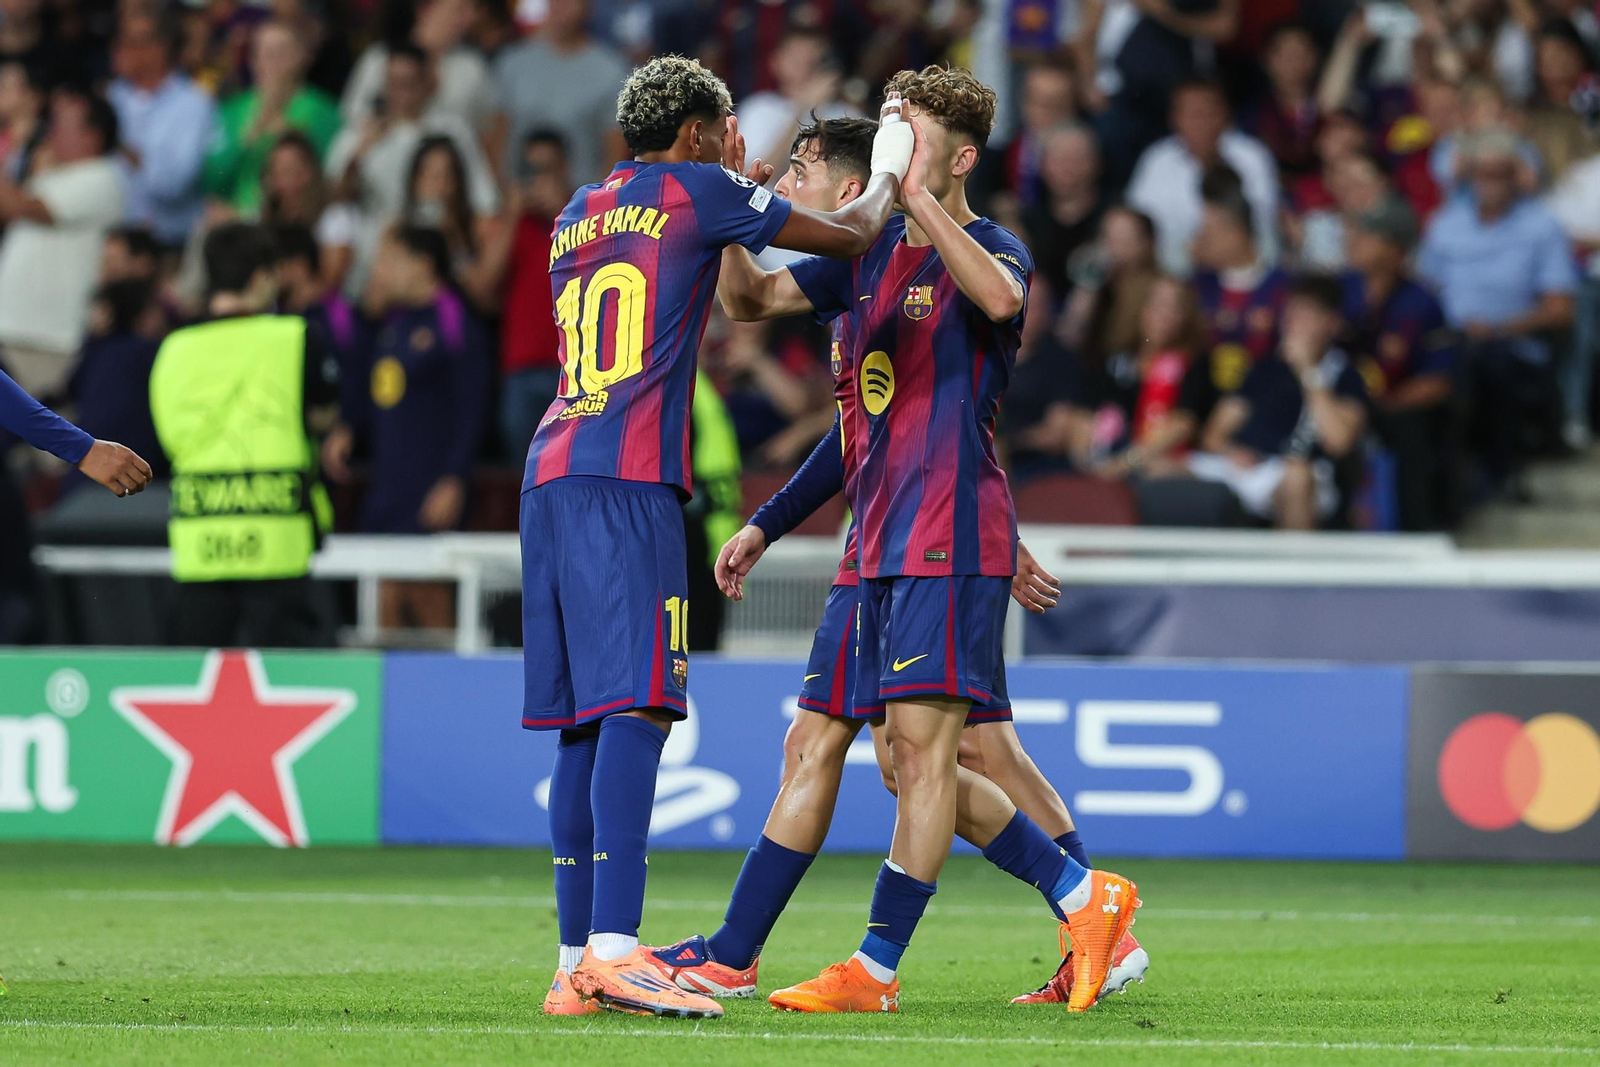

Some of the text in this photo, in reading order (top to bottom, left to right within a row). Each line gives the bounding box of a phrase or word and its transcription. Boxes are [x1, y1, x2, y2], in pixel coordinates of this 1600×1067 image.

[548, 205, 670, 273] AMINE YAMAL
[555, 262, 647, 398] 10
